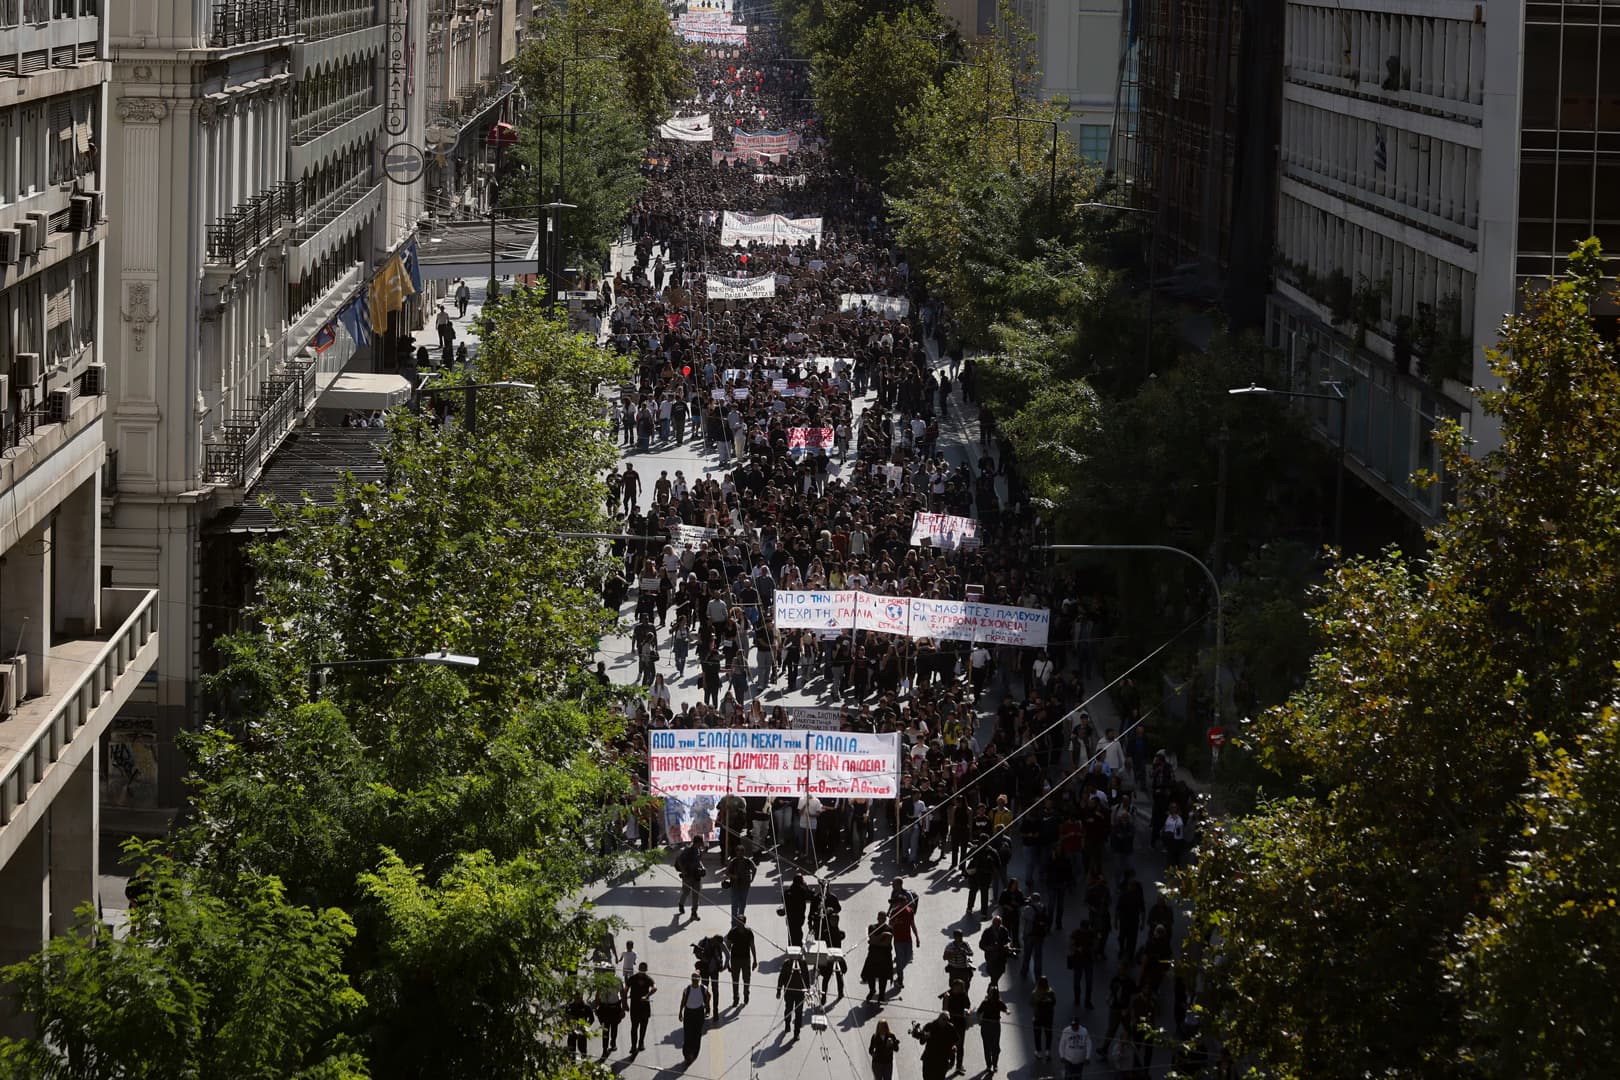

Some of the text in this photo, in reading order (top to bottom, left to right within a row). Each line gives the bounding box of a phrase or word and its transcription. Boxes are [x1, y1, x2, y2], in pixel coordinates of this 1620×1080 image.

[776, 593, 806, 605] ΑΠΟ
[811, 594, 831, 604] ΤΗΝ
[777, 608, 873, 619] ΜΕΧΡΙ ΤΗ ΓΑΛΛΙΑ
[935, 604, 991, 618] ΜΑΘΗΤΕΣ
[996, 609, 1049, 624] ΠΑΛΕΥΟΥΝ
[913, 614, 927, 622] ΓΙΑ
[980, 617, 1028, 632] ΣΧΟΛΕΙΑ!
[653, 732, 675, 749] ΑΠΟ
[698, 732, 748, 748] ΕΛΛΑΔΑ
[751, 733, 782, 749] ΜΕΧΡΙ
[651, 754, 716, 772] ΠΑΛΕΥΟΥΜΕ
[733, 752, 780, 770] ΔΗΜΟΣΙΑ
[782, 759, 789, 770] &
[793, 753, 840, 772] ΔΩΡΕΑΝ
[842, 759, 886, 772] ΠΑΙΔΕΙΑ!
